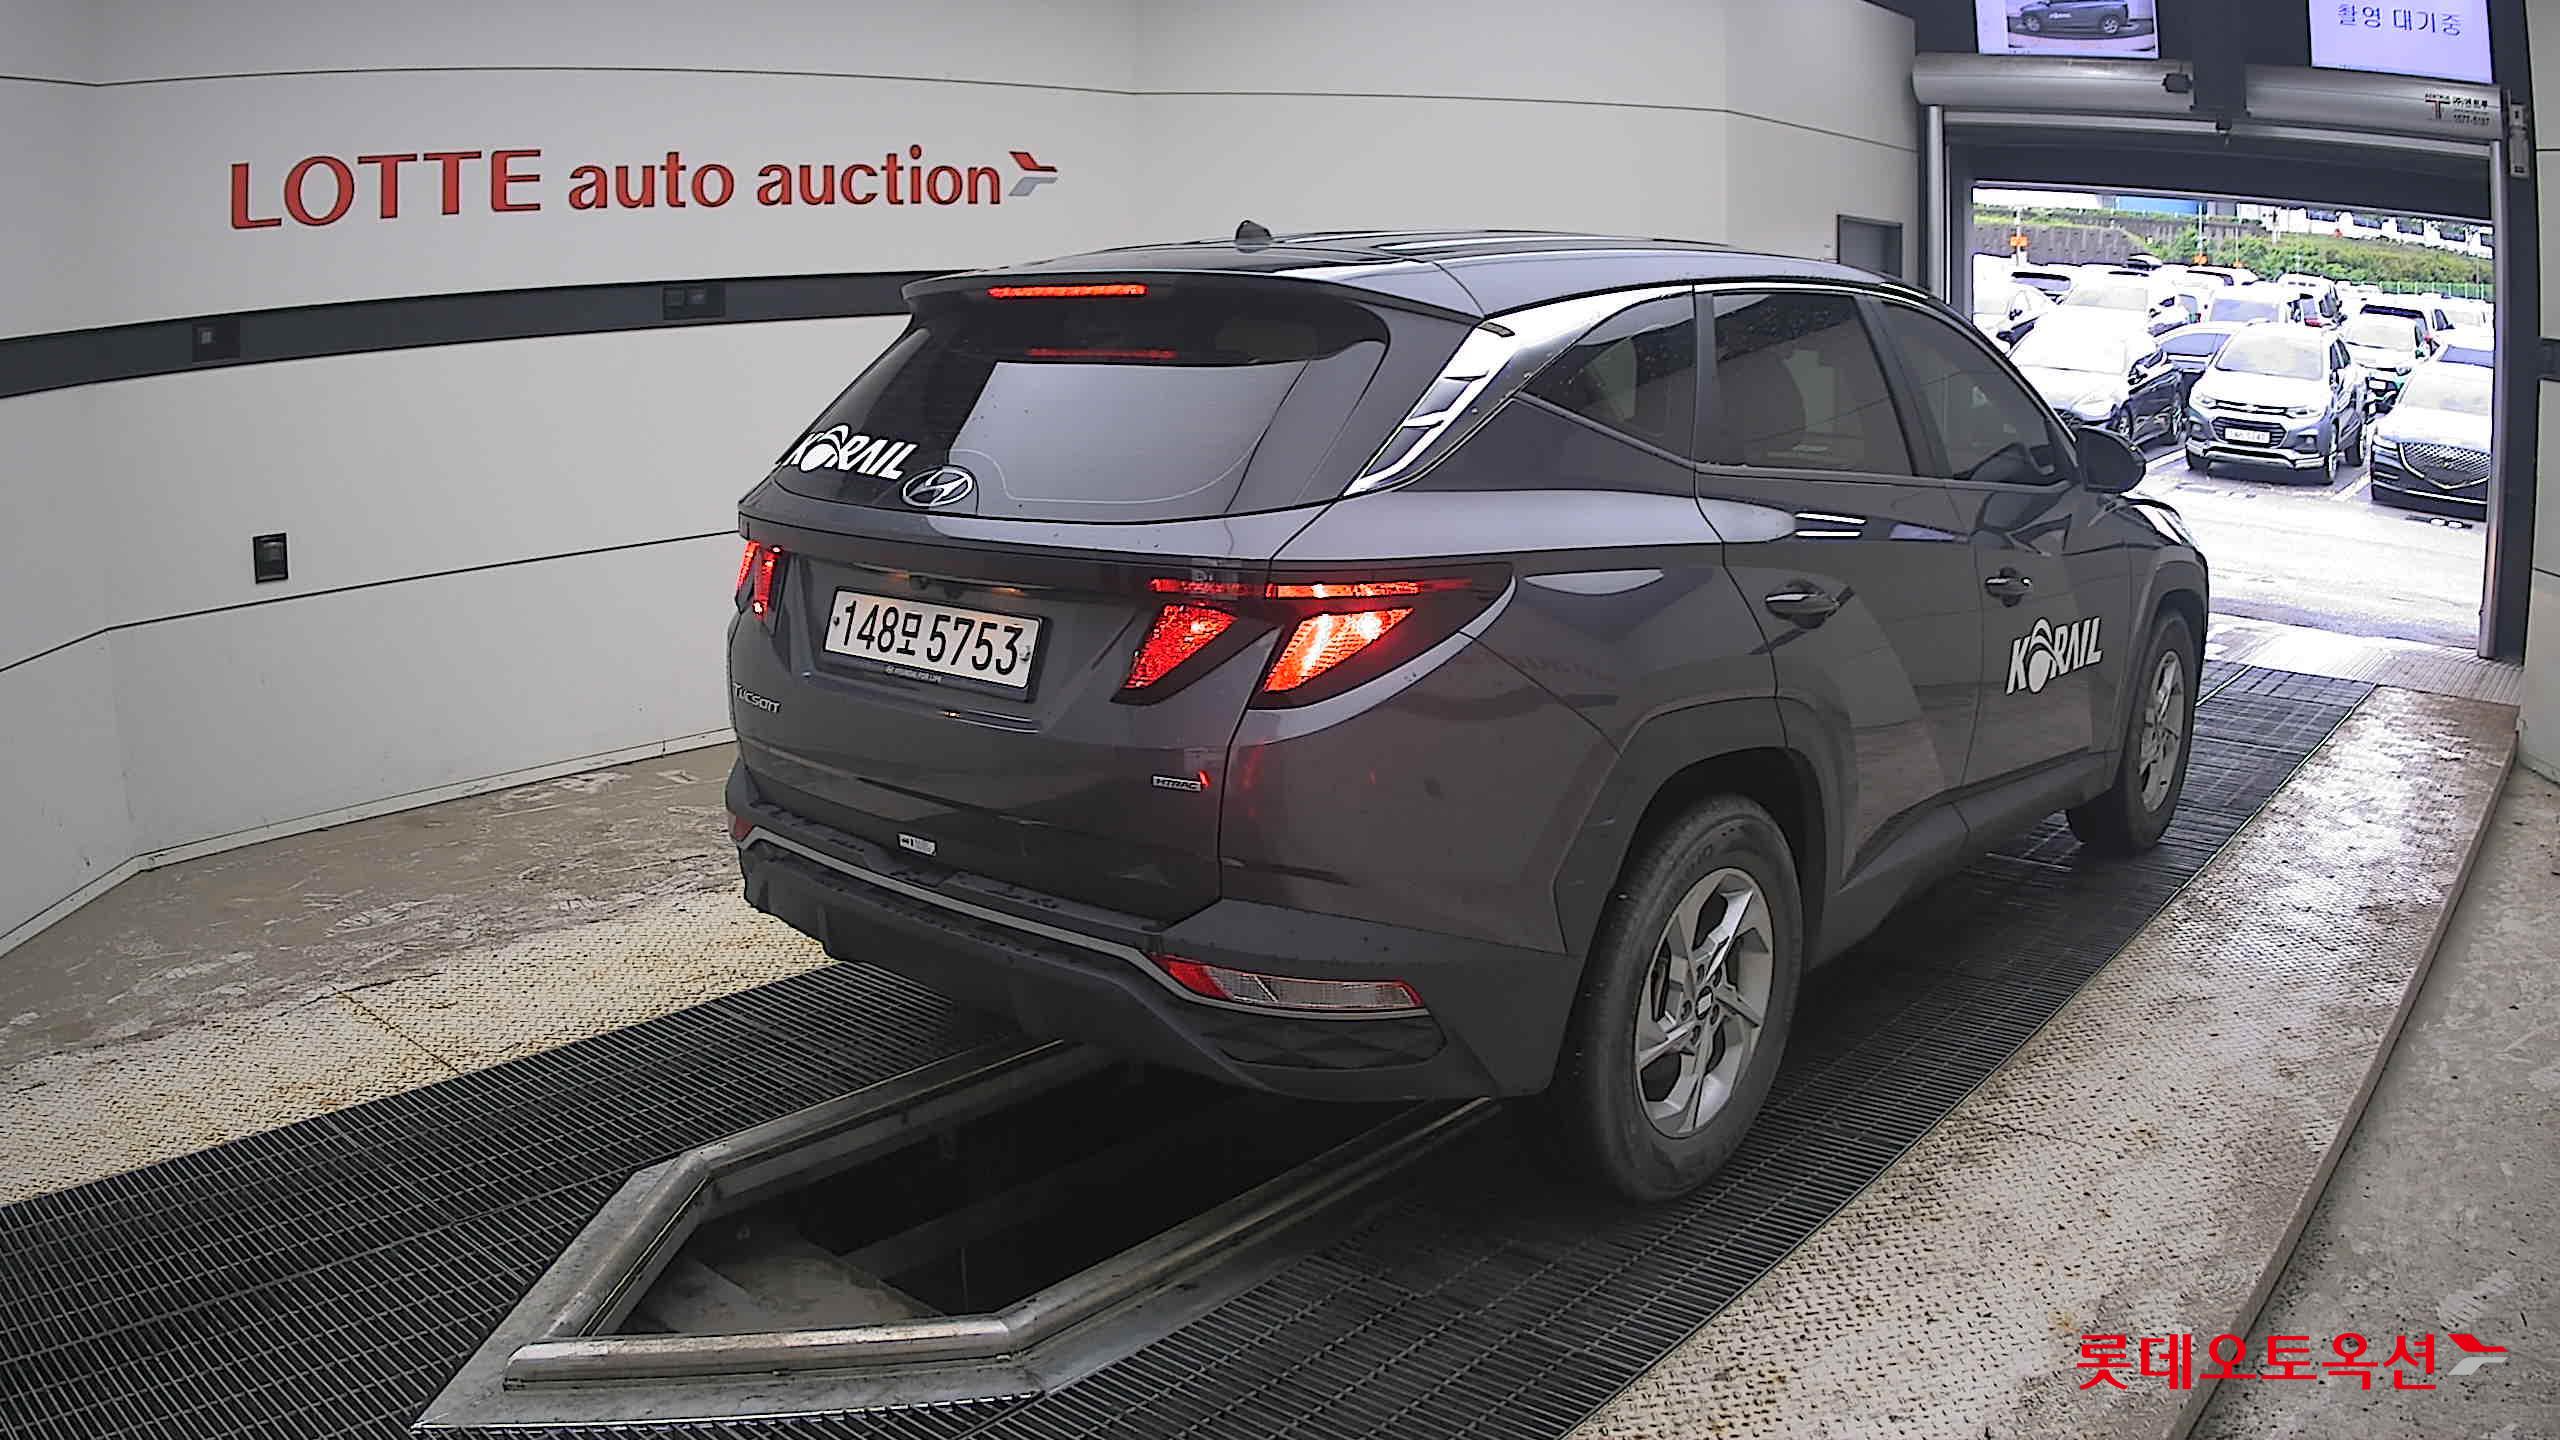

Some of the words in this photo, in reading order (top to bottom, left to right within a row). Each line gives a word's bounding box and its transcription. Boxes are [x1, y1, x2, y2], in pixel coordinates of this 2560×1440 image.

[2337, 3, 2382, 29] 촬영
[2392, 8, 2464, 37] 대기중
[231, 149, 541, 229] LOTTE
[568, 151, 735, 210] auto
[756, 144, 1001, 206] auction
[780, 424, 918, 480] KORAIL
[926, 614, 1024, 676] 5753
[2005, 617, 2103, 695] KORAIL
